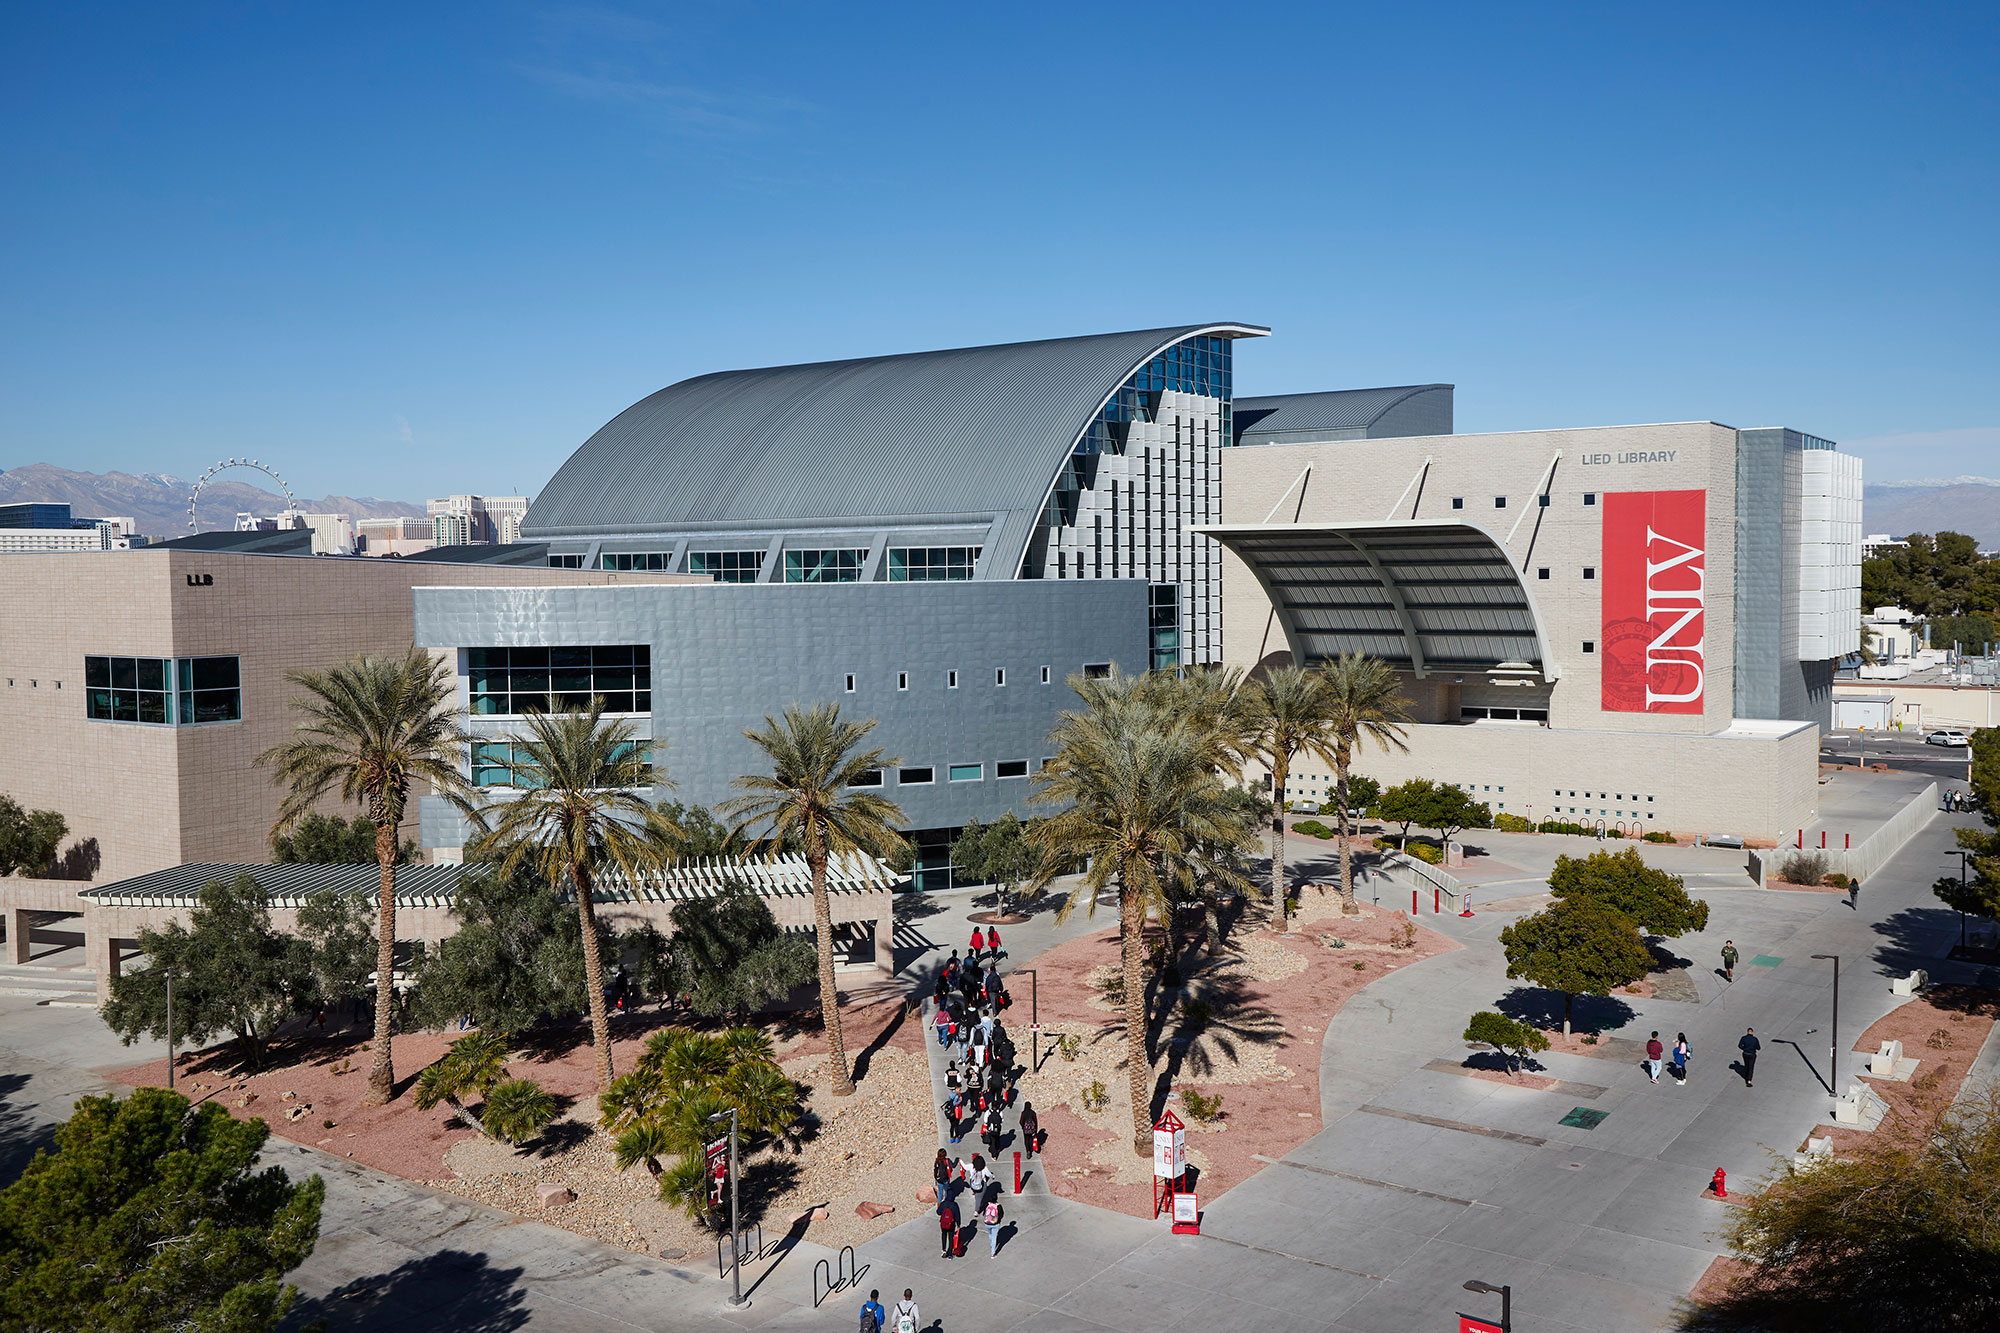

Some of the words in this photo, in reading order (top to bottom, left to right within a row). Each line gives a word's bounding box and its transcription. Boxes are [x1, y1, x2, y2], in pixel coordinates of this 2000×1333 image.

[1582, 453, 1611, 465] LIED
[1617, 450, 1677, 464] LIBRARY
[186, 574, 214, 587] LLB
[1645, 524, 1705, 711] UNLV
